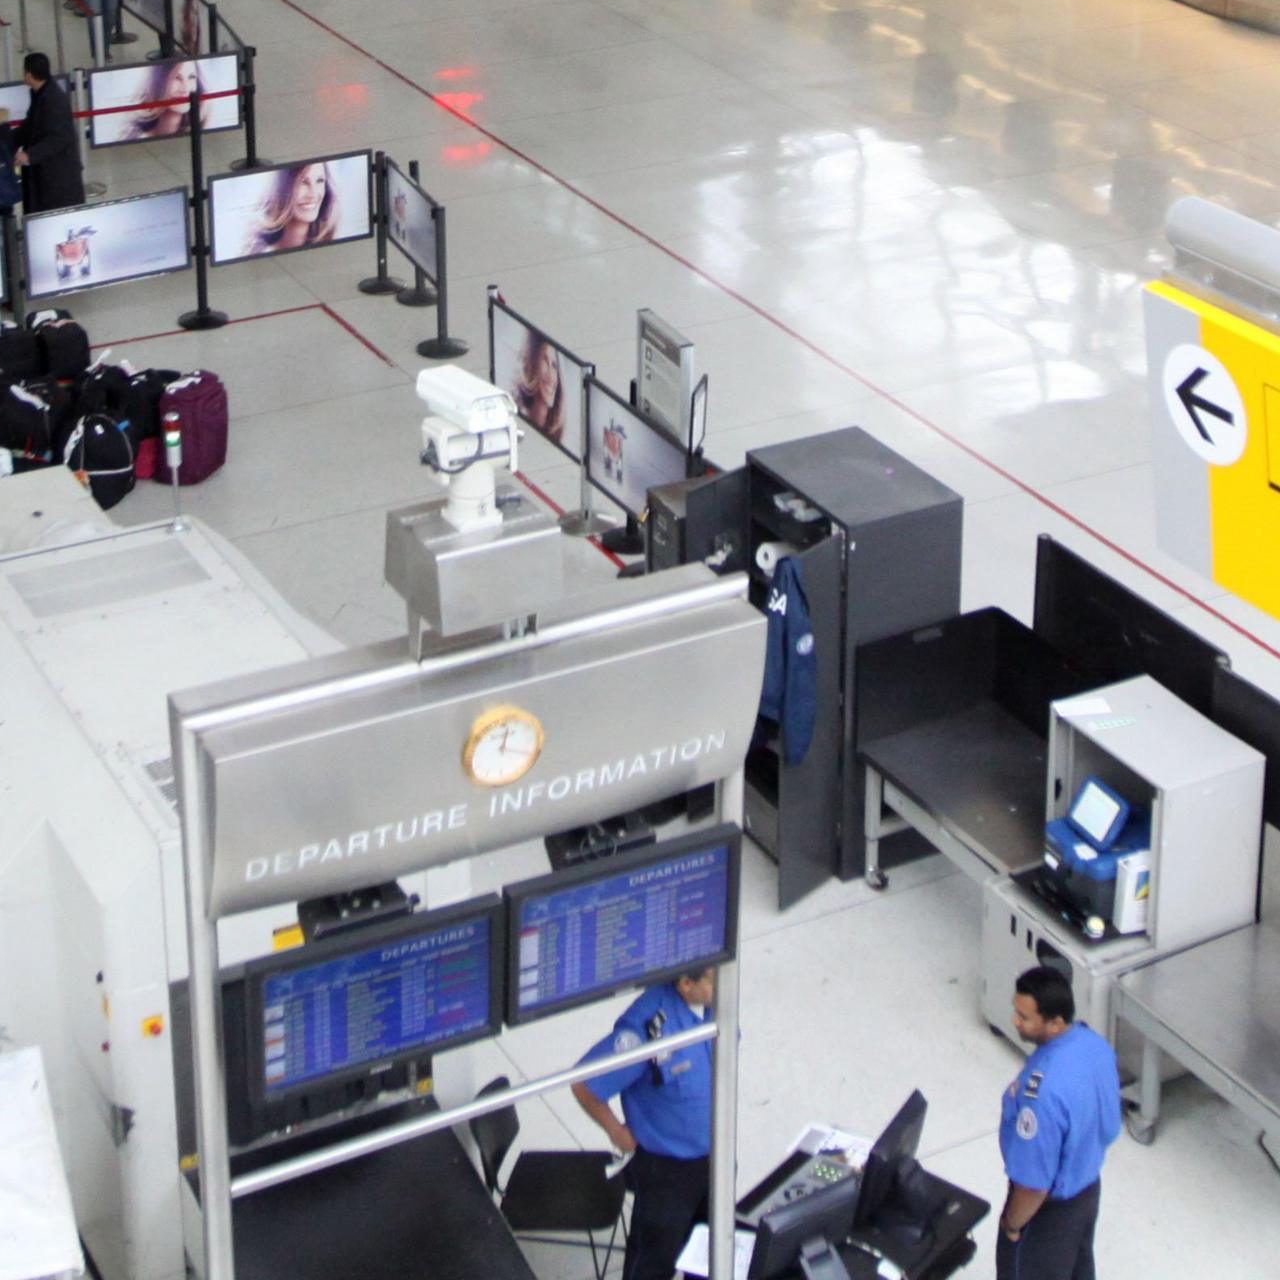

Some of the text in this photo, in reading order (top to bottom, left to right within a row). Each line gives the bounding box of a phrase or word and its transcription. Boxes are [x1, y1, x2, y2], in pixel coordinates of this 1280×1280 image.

[244, 730, 728, 883] DEPARTURE INFORMATION
[628, 854, 716, 888] DEPARTURES
[380, 925, 476, 962] DEPARTURES
